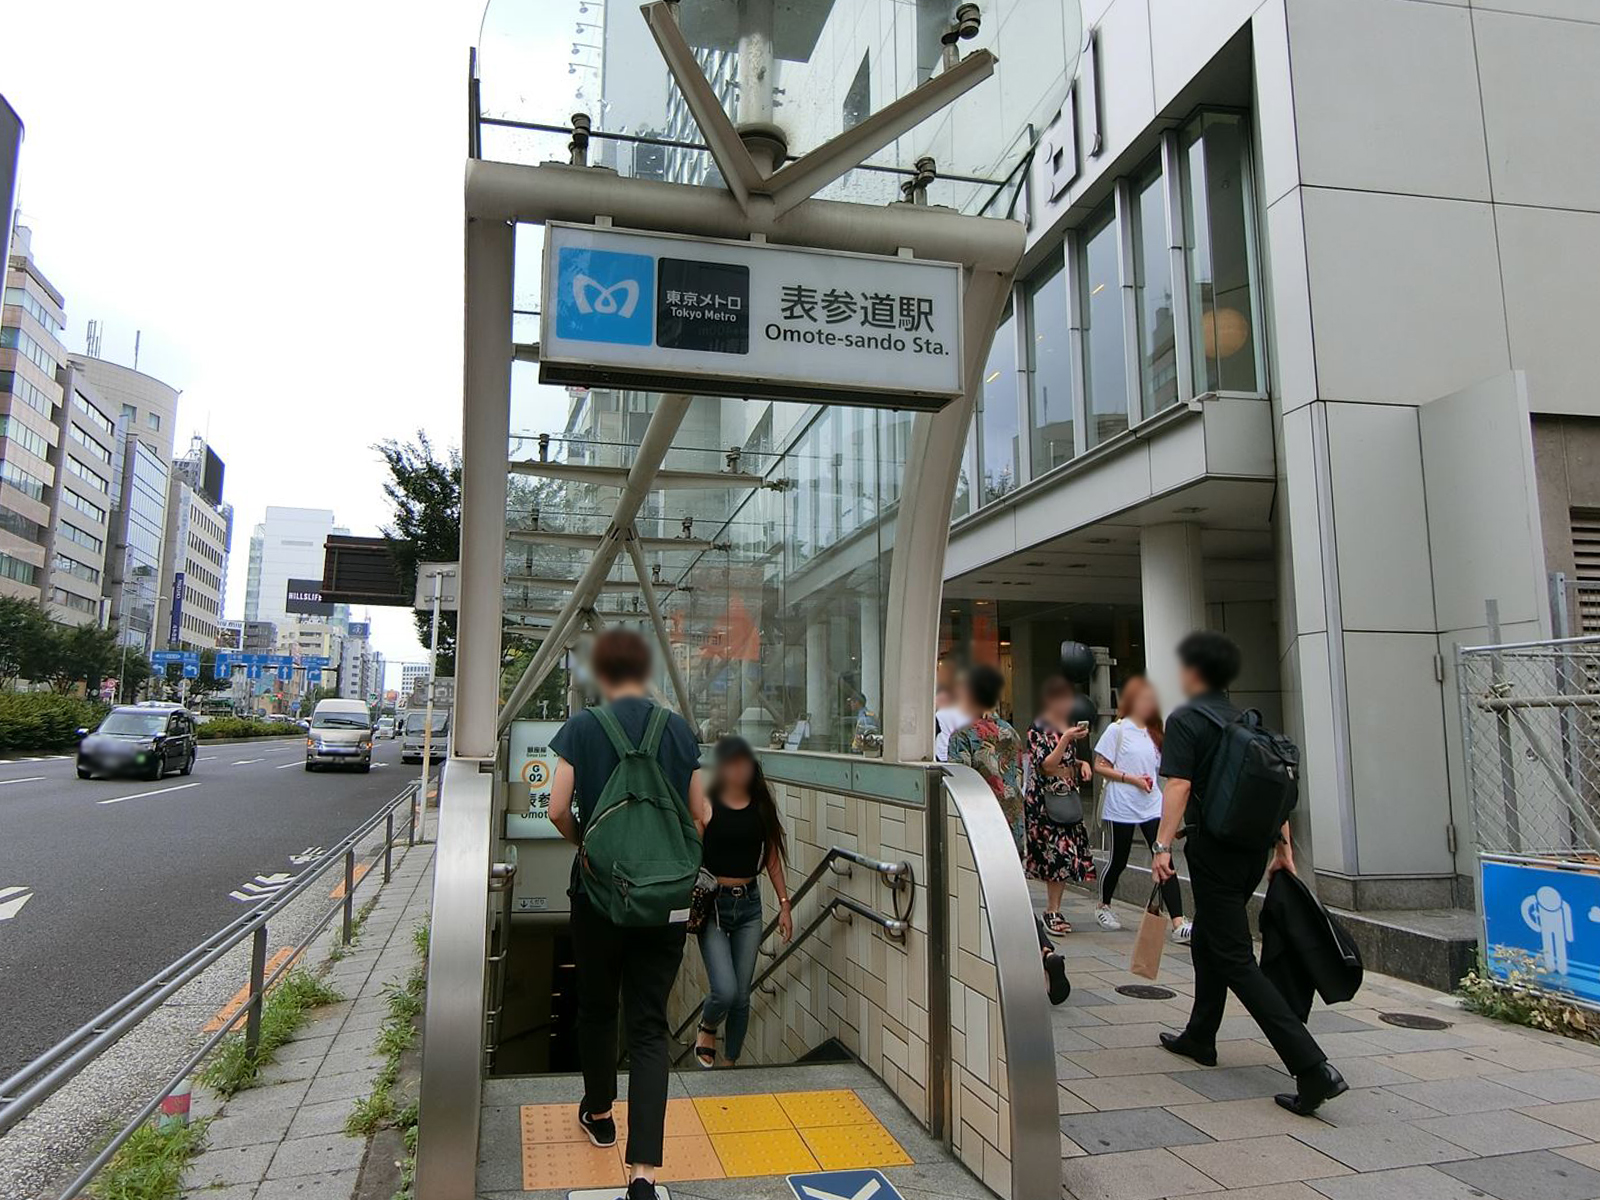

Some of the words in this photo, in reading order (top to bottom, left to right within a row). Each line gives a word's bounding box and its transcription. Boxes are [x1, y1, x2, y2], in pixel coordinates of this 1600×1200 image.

[666, 290, 741, 310] 東京メトロ
[670, 306, 702, 320] Tokyo
[704, 309, 737, 322] Metro
[780, 285, 935, 333] 表参道駅
[765, 323, 906, 352] Omote-sando
[912, 337, 950, 356] Sta.
[532, 764, 540, 773] G
[529, 773, 543, 782] 02
[521, 810, 548, 819] Omot
